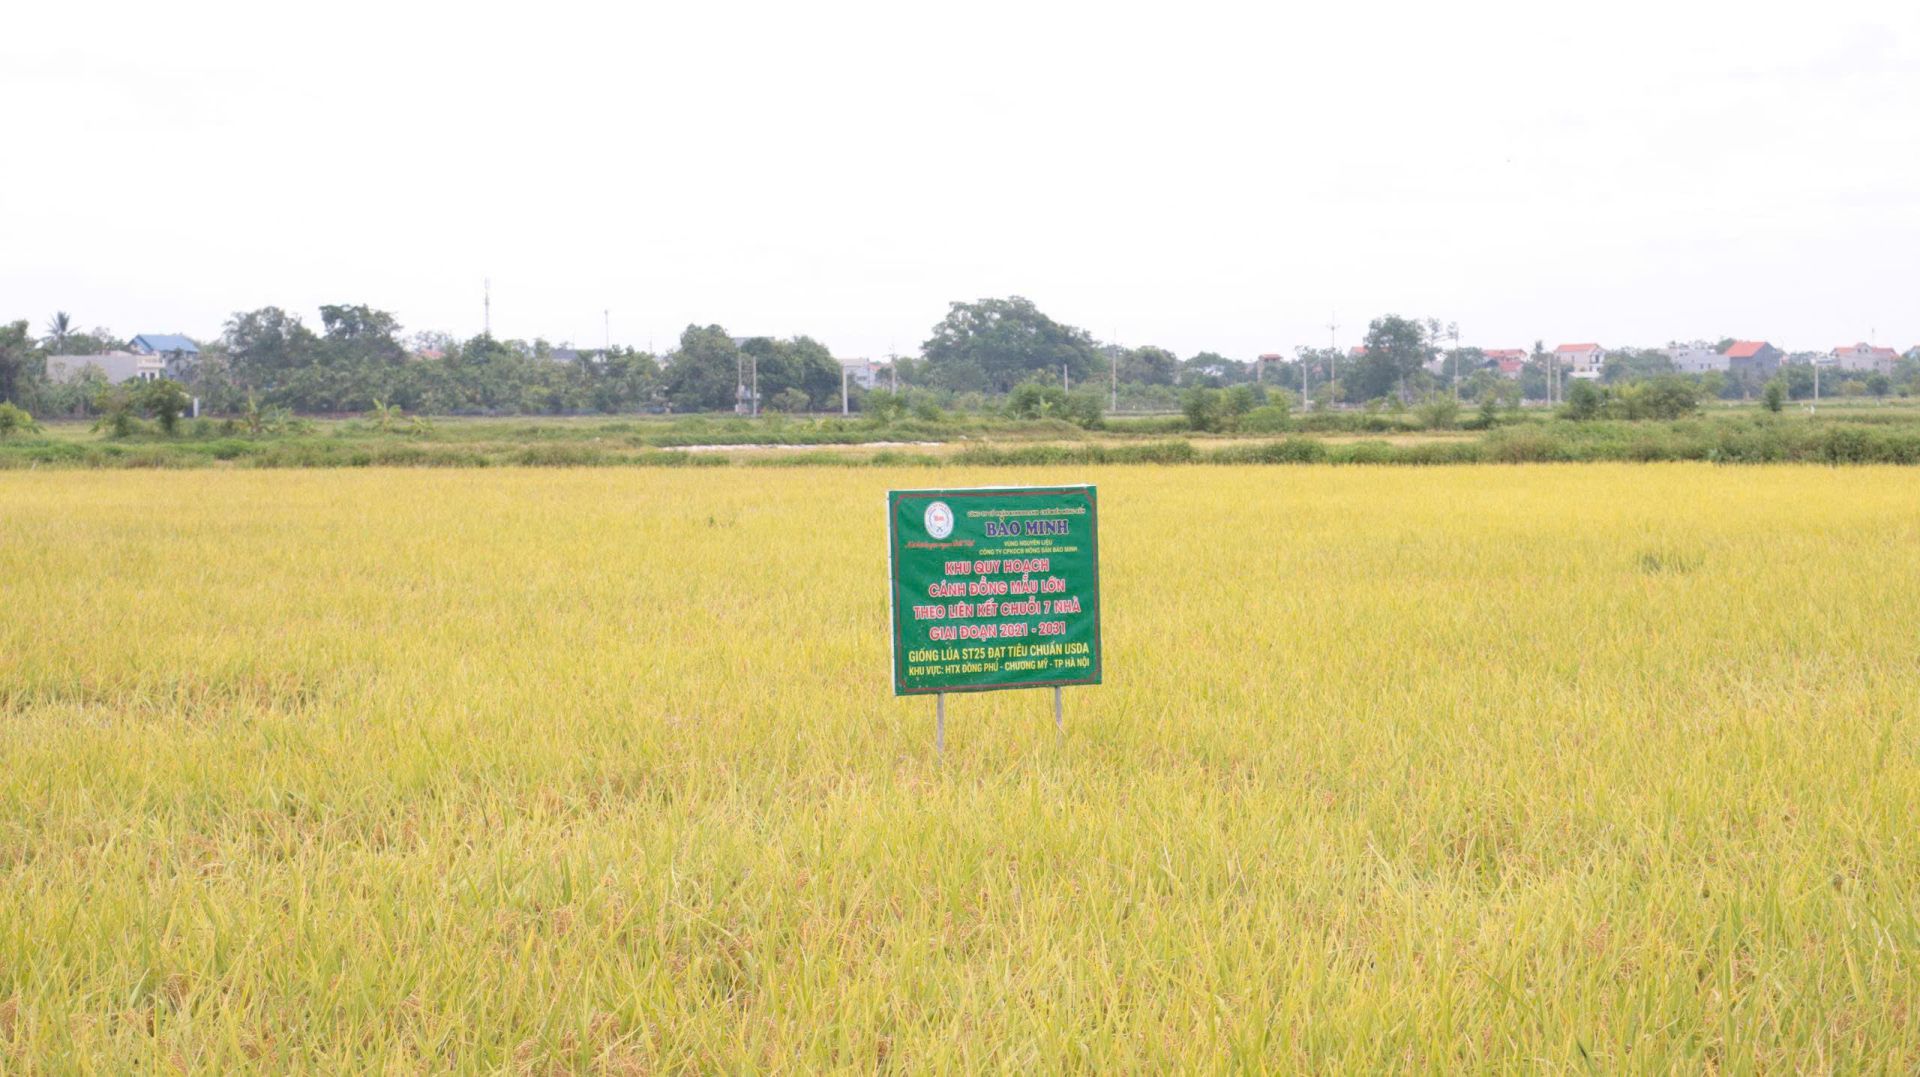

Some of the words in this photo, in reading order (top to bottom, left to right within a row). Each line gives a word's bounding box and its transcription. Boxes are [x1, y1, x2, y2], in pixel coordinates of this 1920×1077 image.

[1025, 519, 1069, 535] MINH
[945, 561, 971, 575] KHU
[974, 560, 1000, 574] QUY
[1004, 558, 1050, 573] HOẠCH
[929, 579, 966, 597] CÁNH
[969, 575, 1007, 596] ĐỒNG
[1010, 572, 1038, 594] MẪU
[913, 605, 946, 620] THEO
[949, 600, 974, 618] LIÊN
[977, 597, 998, 617] KẾT
[1001, 596, 1041, 616] CHUỖI
[1044, 600, 1051, 614] 7
[1054, 596, 1082, 613] NHÀ
[929, 627, 957, 640] GIAI
[960, 624, 997, 642] ĐOẠN
[1000, 623, 1028, 637] 2021
[1039, 621, 1066, 635] 2031
[908, 647, 939, 662] GIỐNG
[941, 646, 960, 660] LÚA
[962, 647, 986, 660] ST25
[988, 646, 1006, 660] ĐẠT
[1008, 643, 1028, 657] TIÊU
[1064, 642, 1090, 655] USDA
[908, 666, 925, 676] KHU
[945, 664, 961, 674] HTX
[1054, 659, 1064, 668] TP
[1064, 657, 1076, 668] HÀ
[1077, 655, 1090, 669] NỘI
